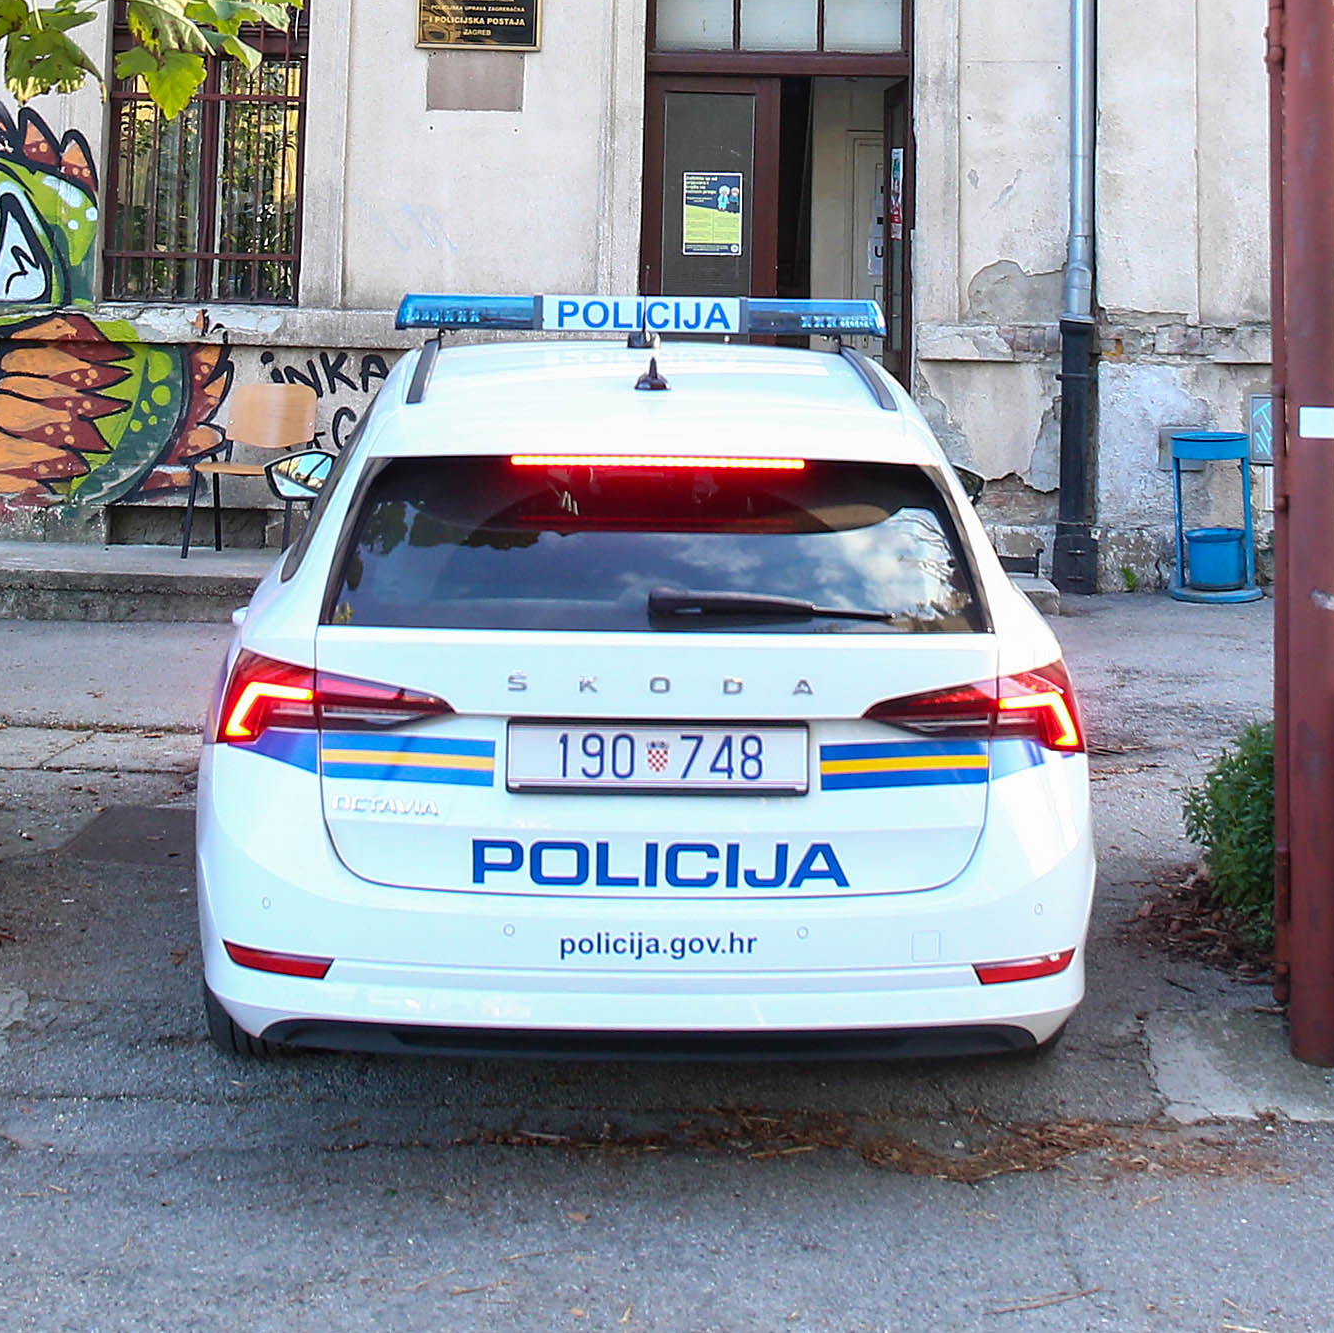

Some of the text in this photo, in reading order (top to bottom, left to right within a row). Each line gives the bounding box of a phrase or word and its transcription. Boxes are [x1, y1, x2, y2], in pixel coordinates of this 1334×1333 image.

[434, 16, 486, 25] POLICIJSKA
[486, 17, 526, 27] POSTAJA
[462, 28, 492, 37] ZAGREB
[558, 300, 731, 330] POLICIJA
[559, 733, 764, 780] 190 748
[331, 794, 440, 816] OCTAVIA
[472, 839, 851, 888] POLICIJA
[559, 932, 758, 960] policija.gov.hr
